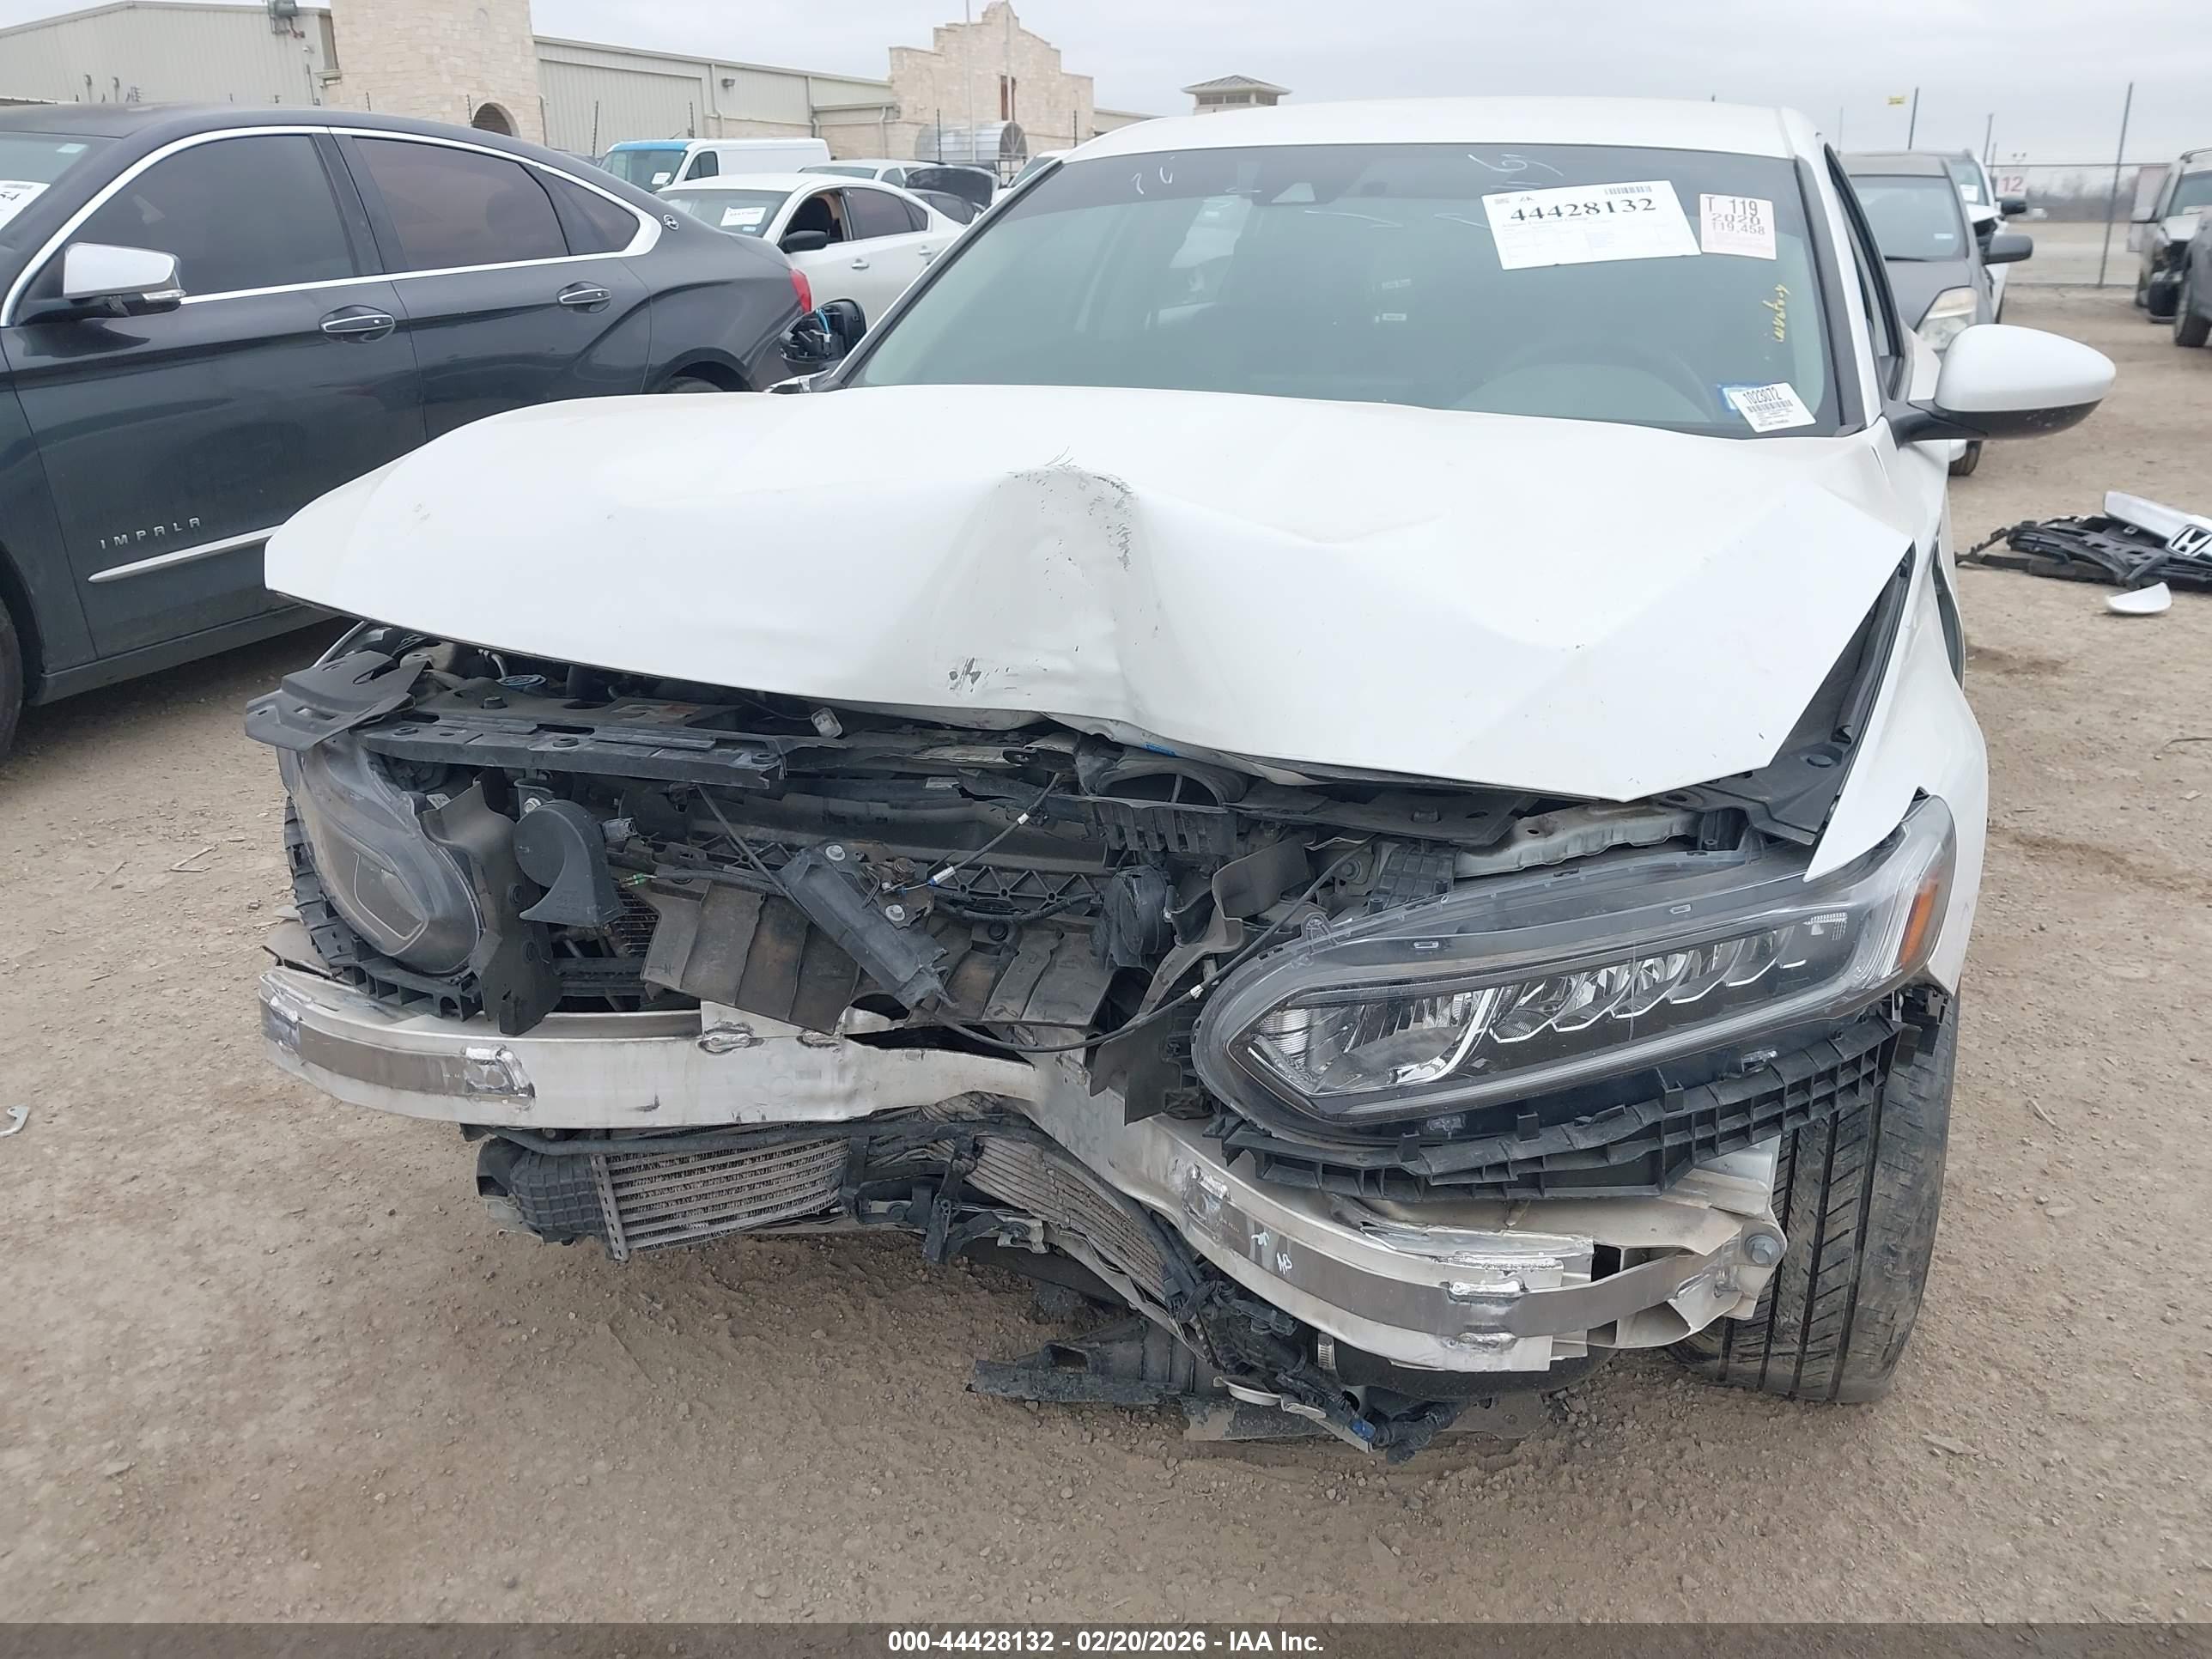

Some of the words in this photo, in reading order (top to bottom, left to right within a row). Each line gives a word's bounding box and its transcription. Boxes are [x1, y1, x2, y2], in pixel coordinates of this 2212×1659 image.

[2002, 176, 2024, 193] 12
[1510, 198, 1656, 221] 44428132
[1705, 197, 1716, 213] T
[1729, 199, 1759, 217] 119
[1711, 212, 1761, 226] 2020
[1742, 386, 1783, 404] 1023072
[100, 517, 201, 550] IMPALA
